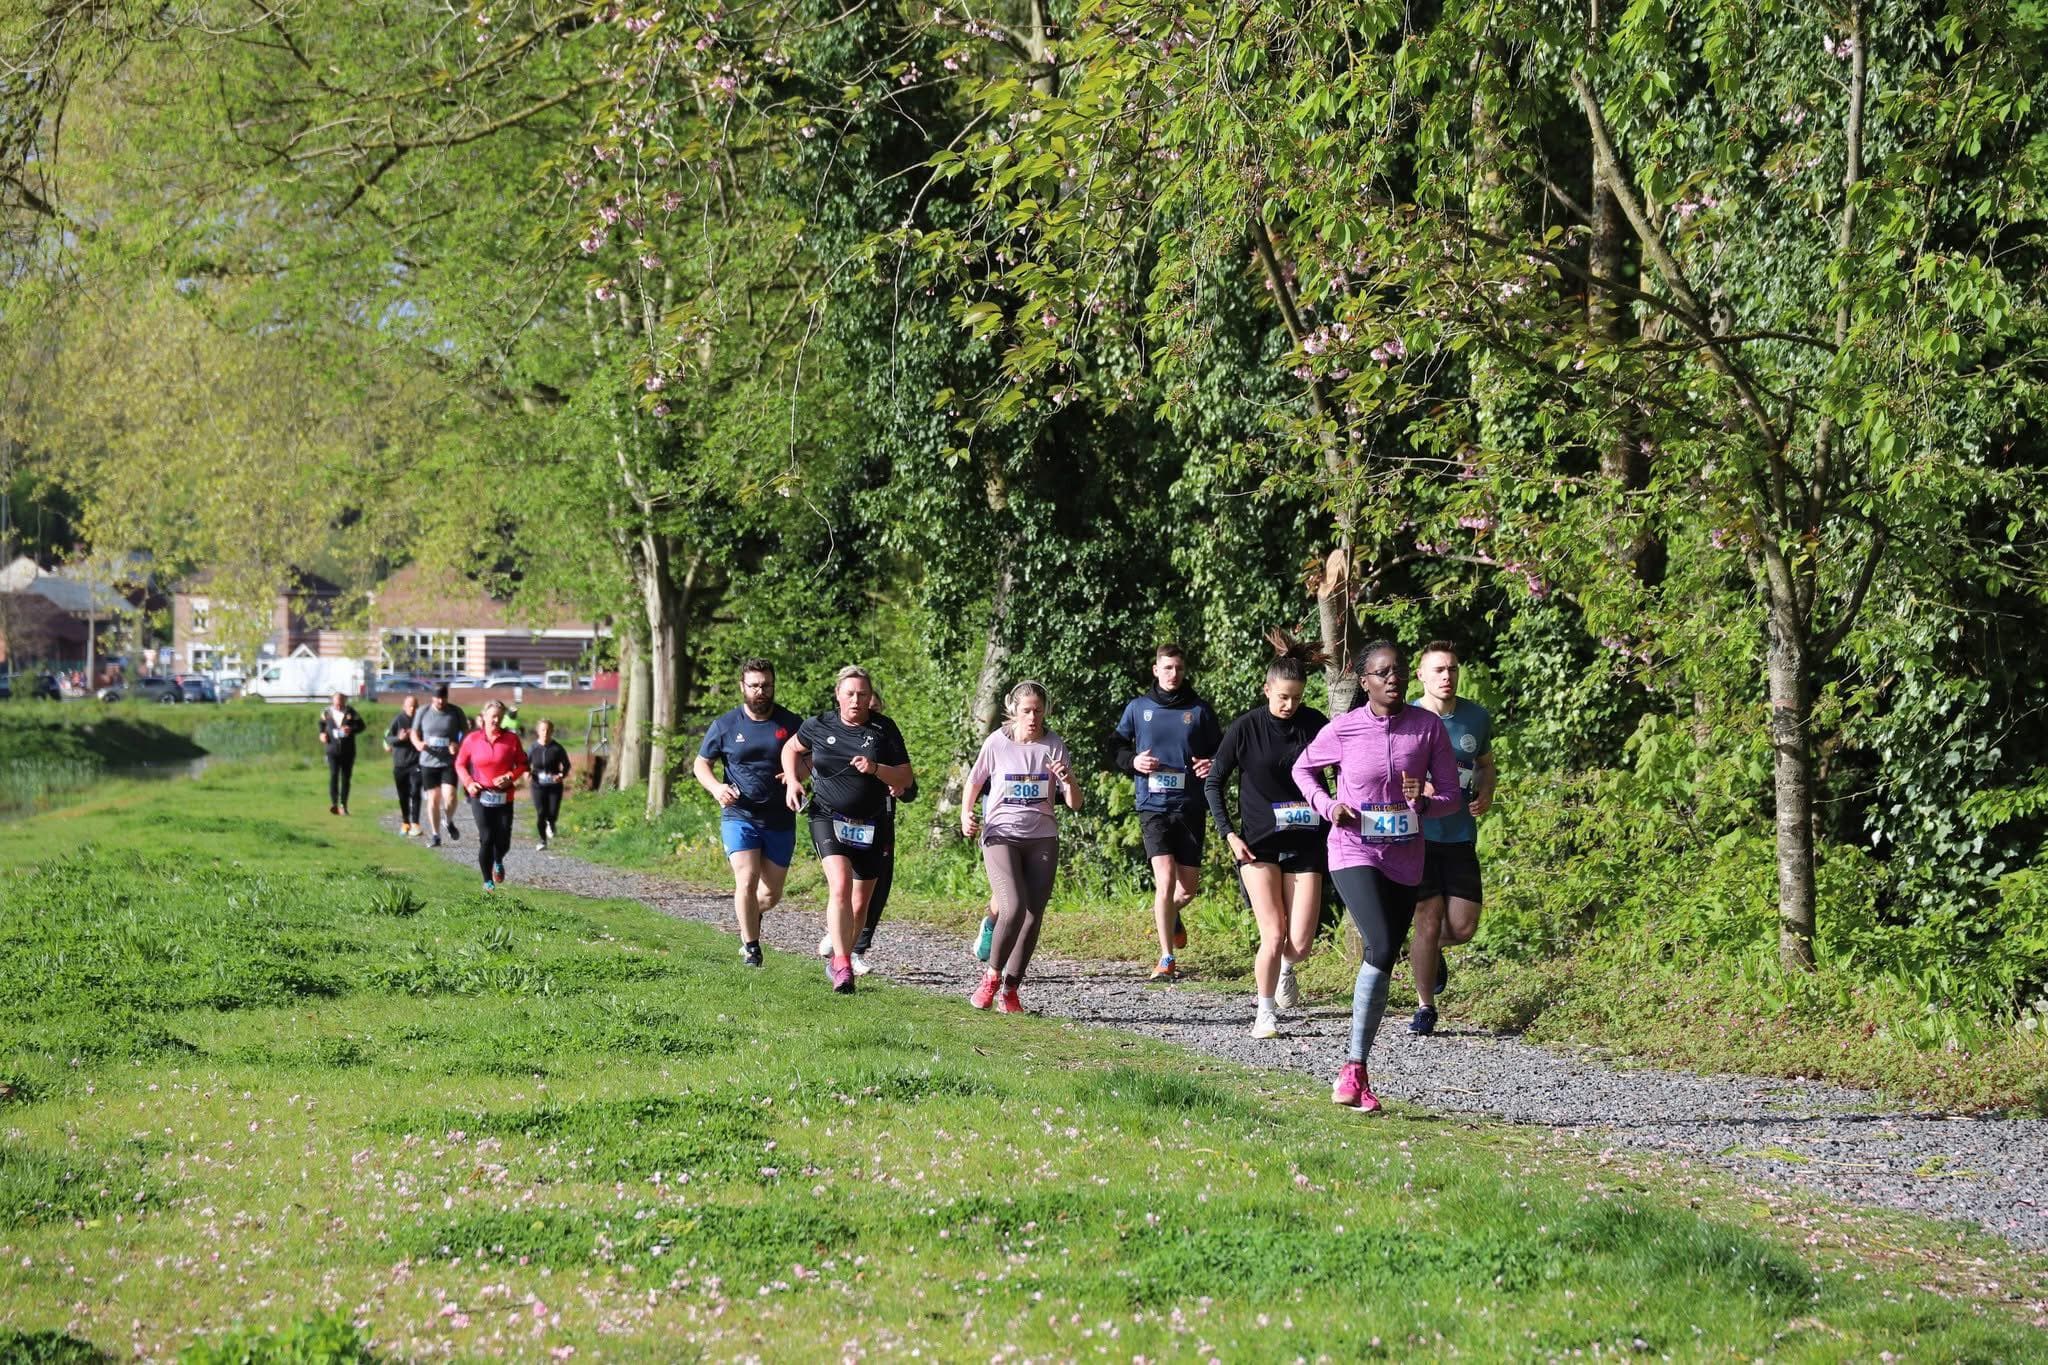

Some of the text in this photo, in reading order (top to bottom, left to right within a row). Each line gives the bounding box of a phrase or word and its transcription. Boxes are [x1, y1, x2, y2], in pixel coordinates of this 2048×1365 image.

[1013, 784, 1040, 797] 308
[1285, 810, 1311, 824] 346
[1374, 815, 1409, 833] 415
[841, 826, 865, 841] 416
